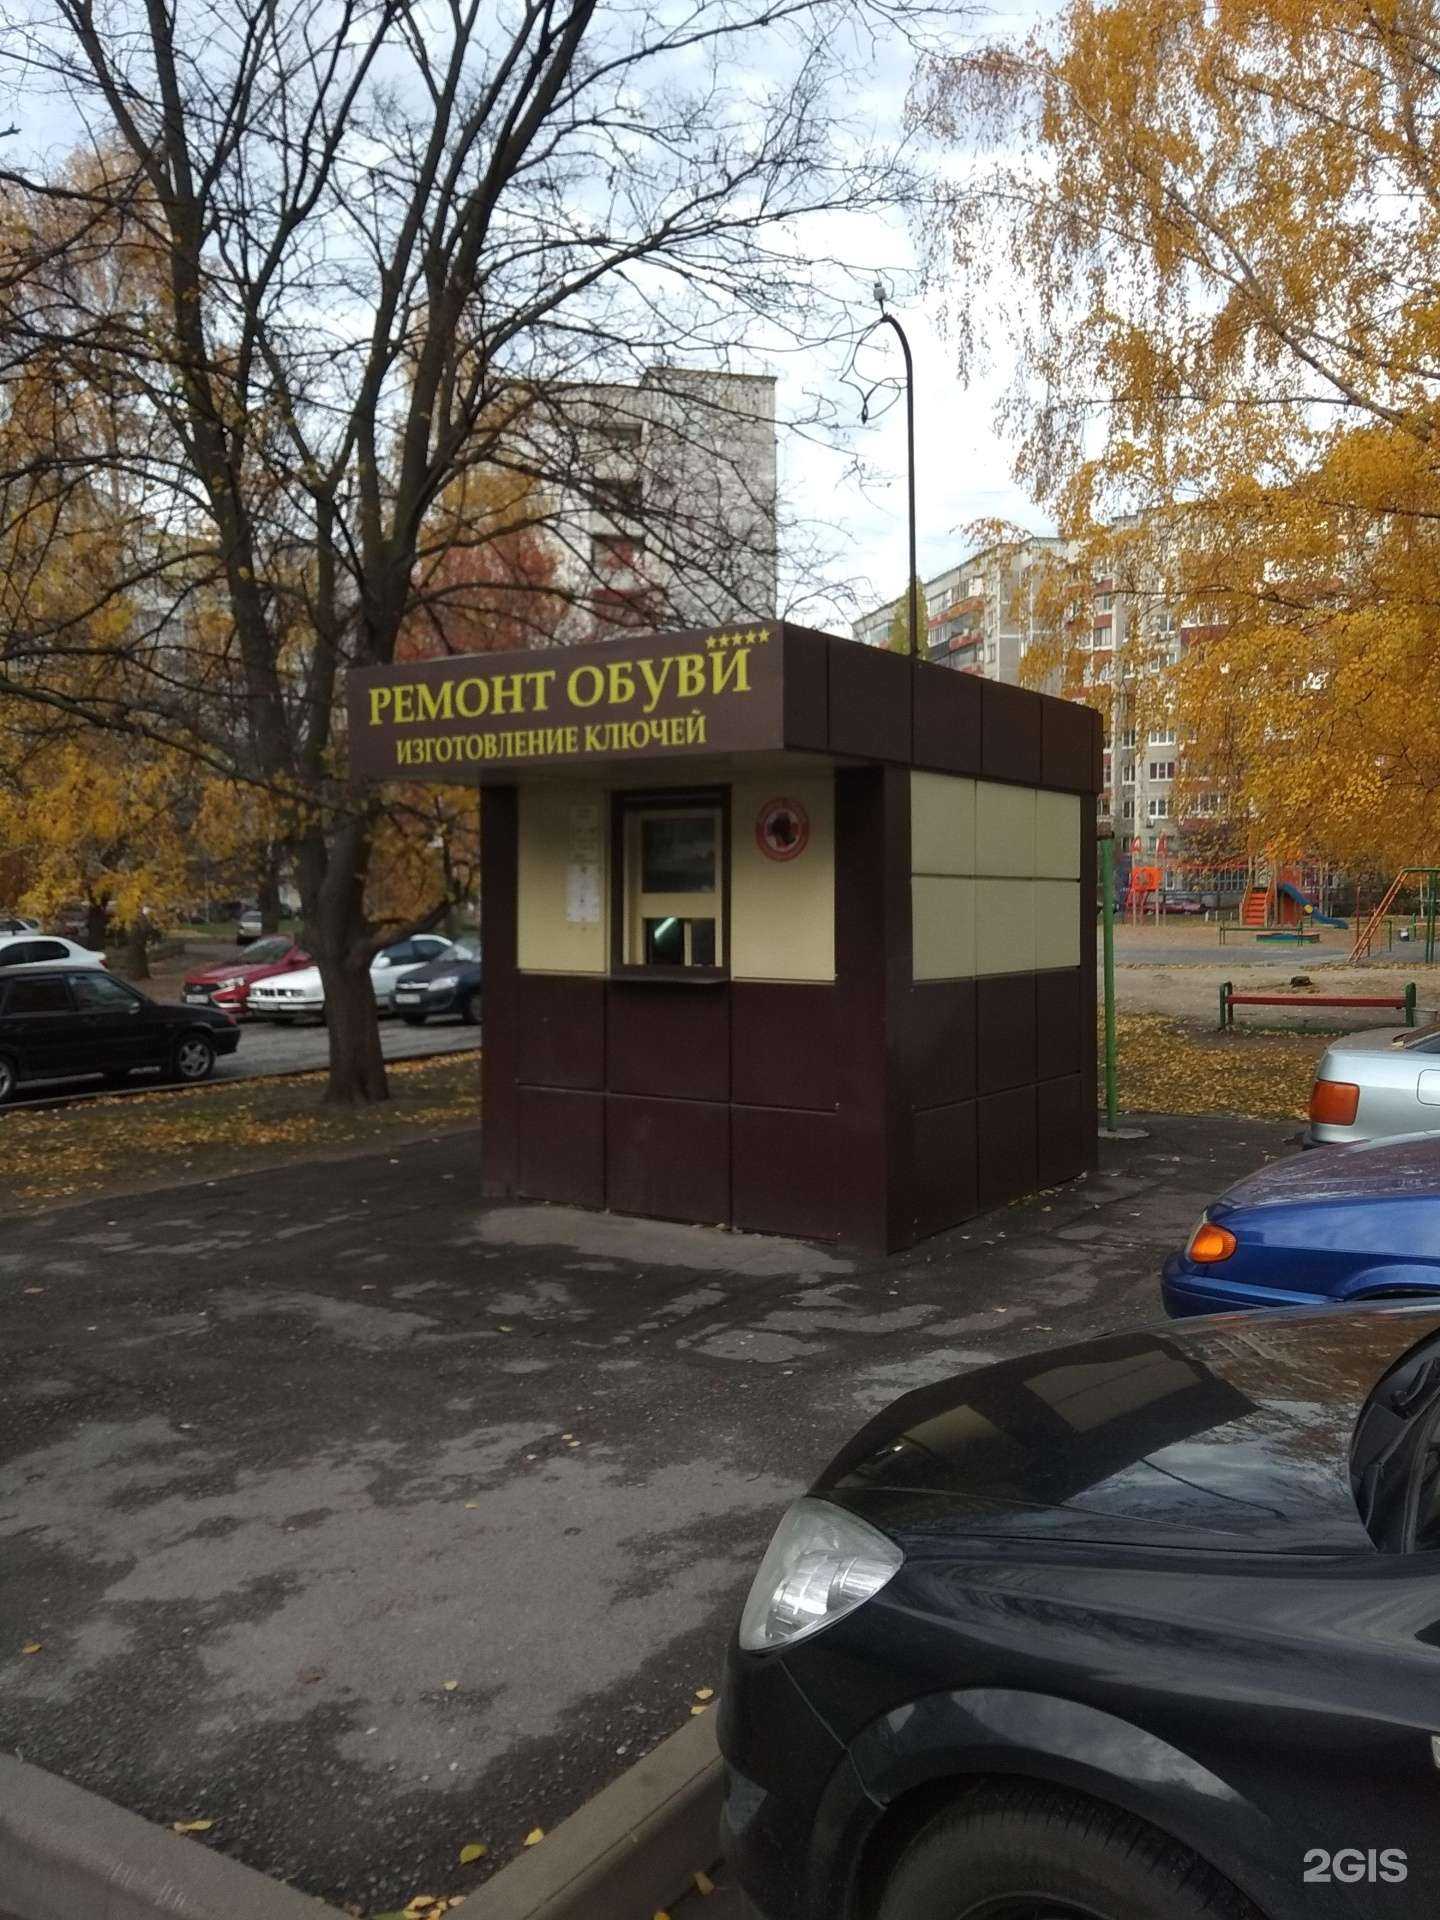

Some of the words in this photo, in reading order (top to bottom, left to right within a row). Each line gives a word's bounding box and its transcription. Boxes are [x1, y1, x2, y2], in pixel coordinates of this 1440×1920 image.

[368, 670, 556, 726] РЕМОНТ
[567, 647, 752, 713] ОБУВИ
[396, 725, 579, 765] ИЗГОТОВЛЕНИЕ
[584, 709, 707, 752] КЛЮЧЕЙ
